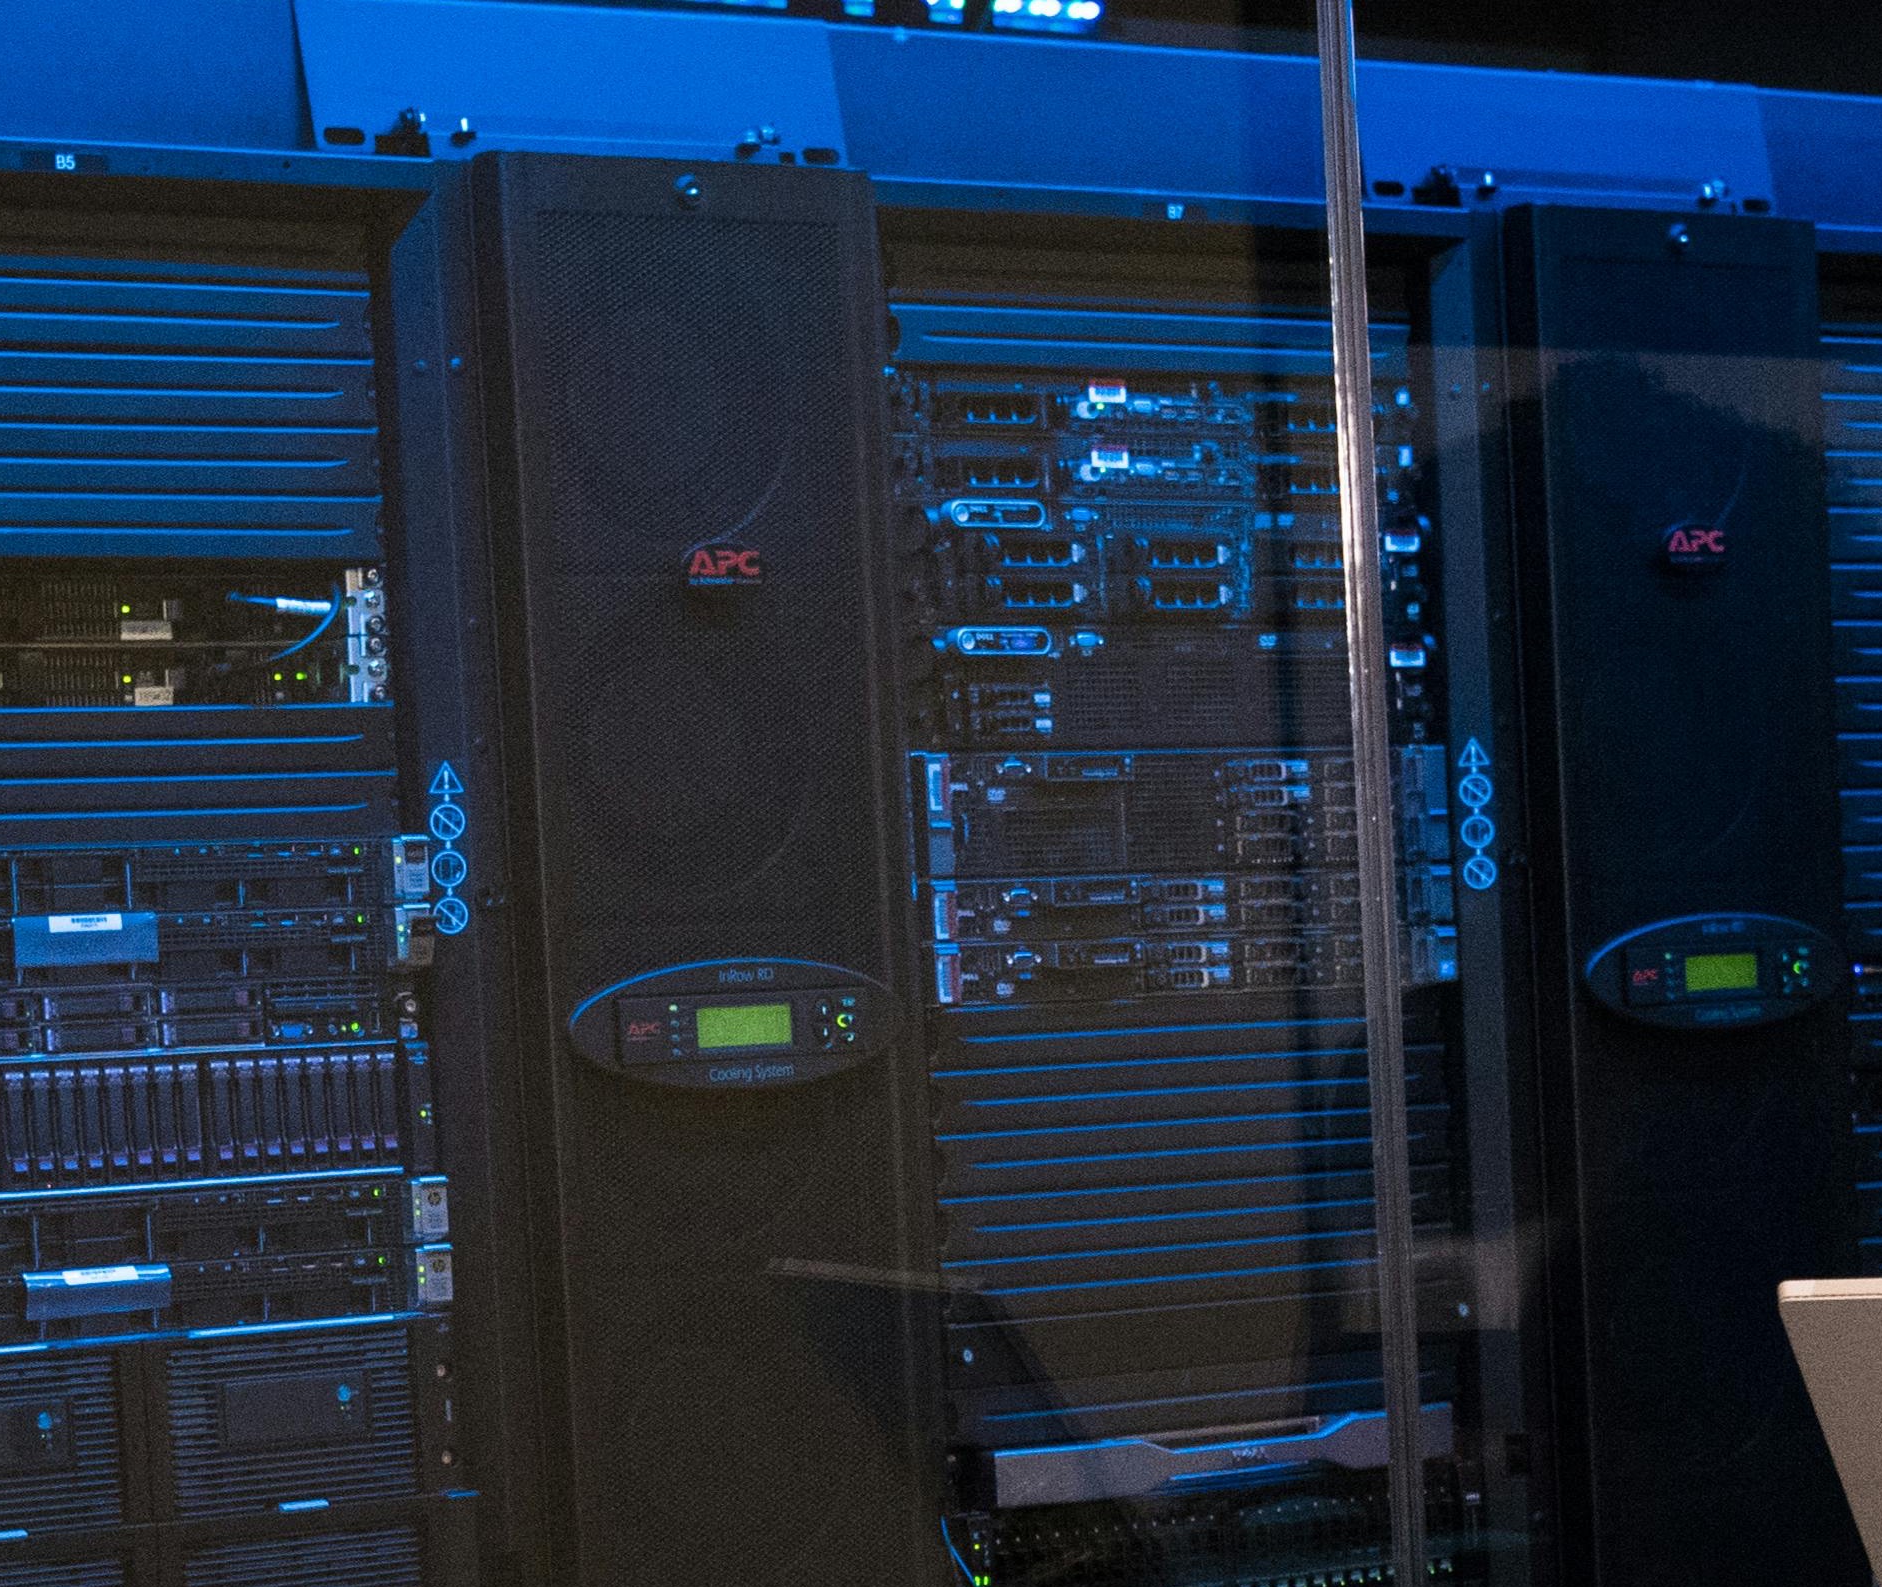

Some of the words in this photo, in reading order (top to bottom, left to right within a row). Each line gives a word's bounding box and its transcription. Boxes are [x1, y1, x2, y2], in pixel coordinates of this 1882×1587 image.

[54, 153, 76, 171] B5
[1667, 529, 1726, 554] APC
[687, 549, 761, 577] APC
[755, 1062, 796, 1080] System
